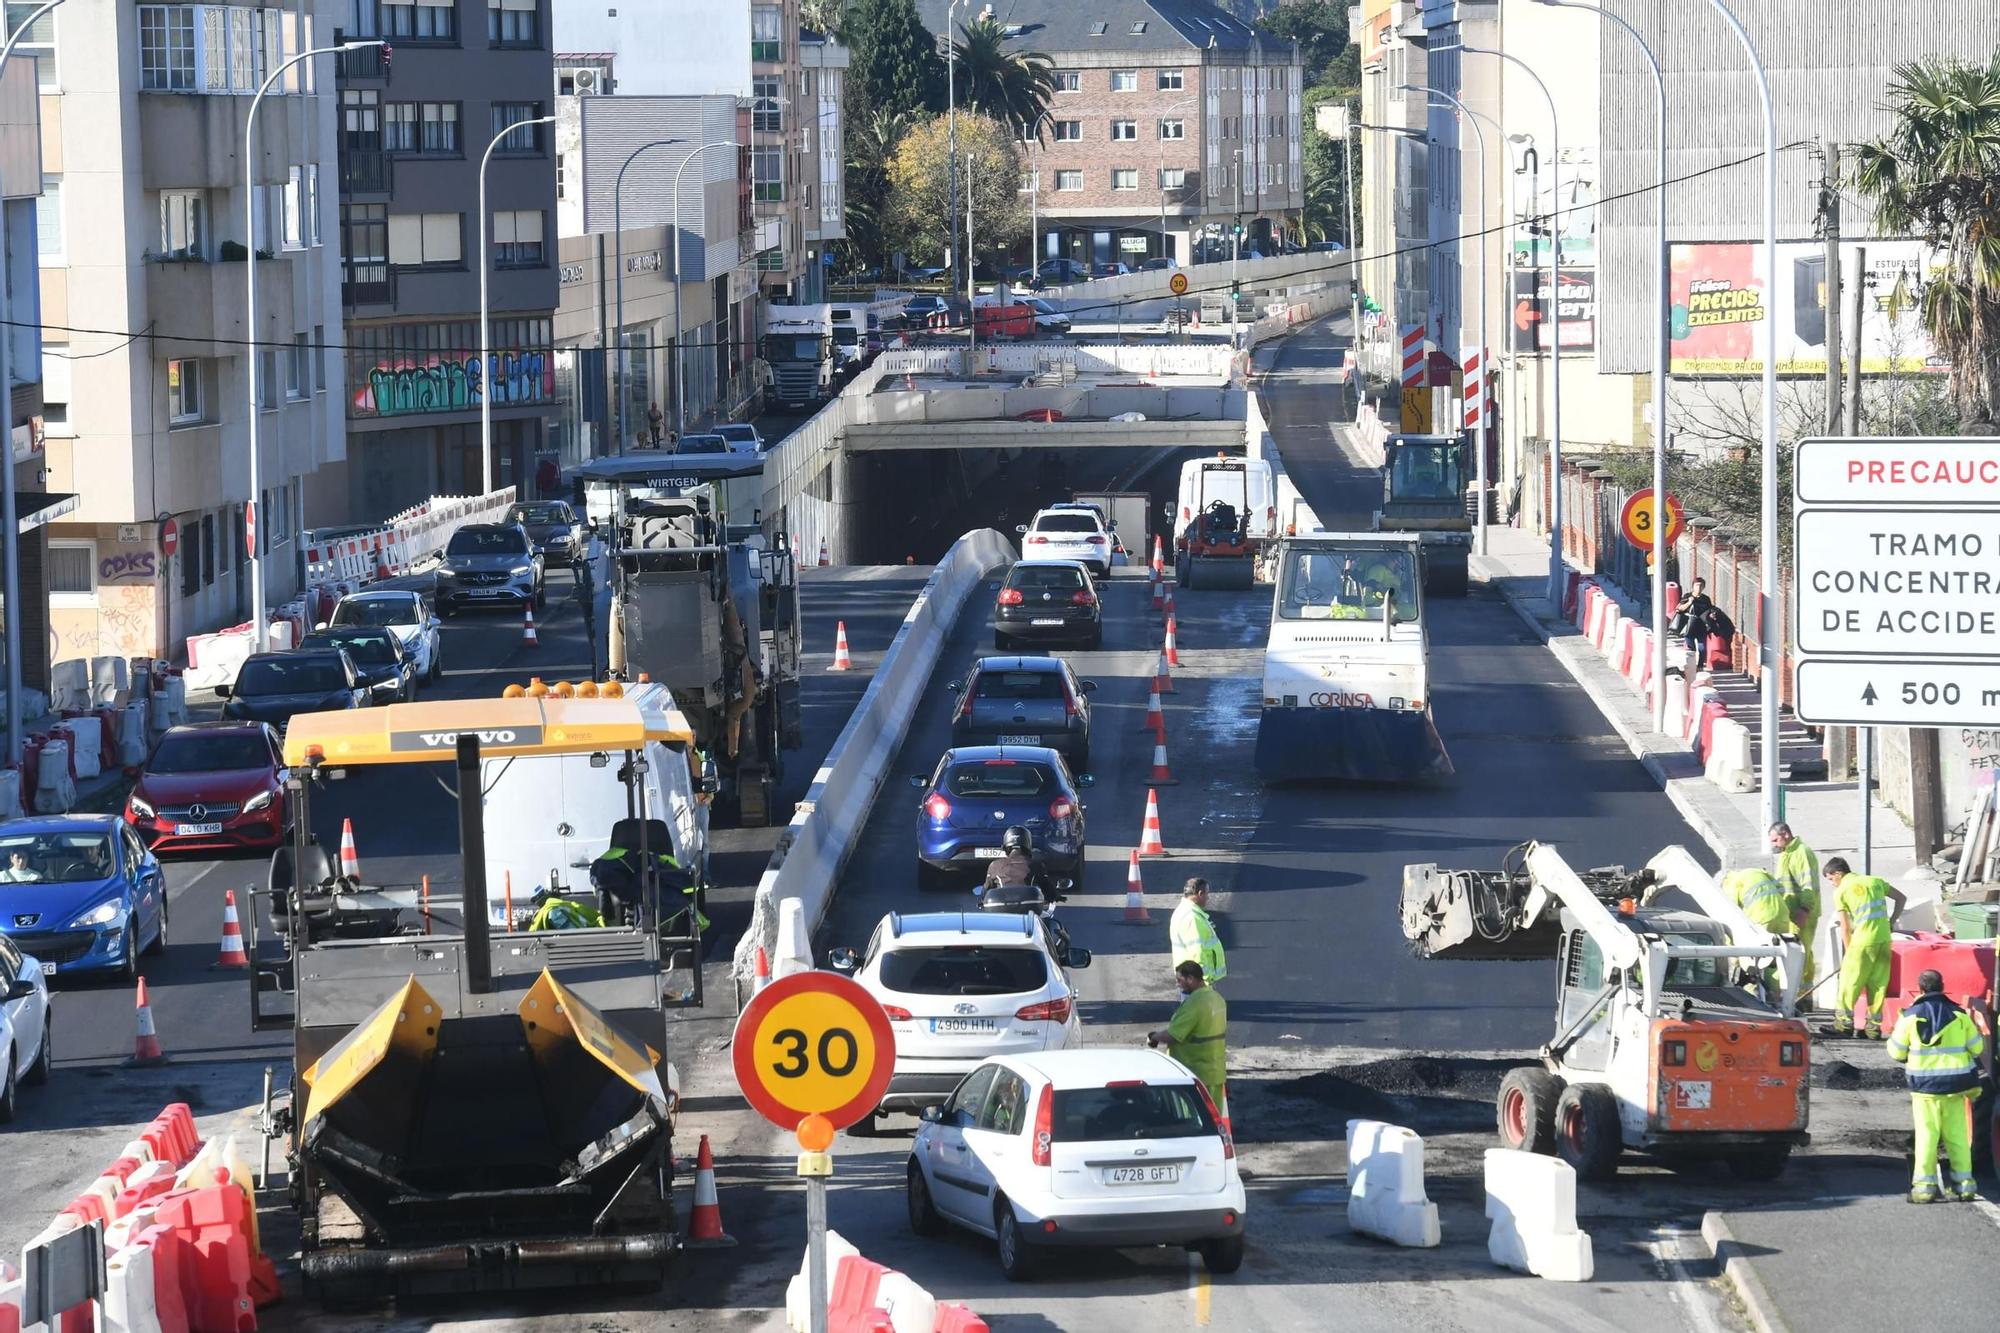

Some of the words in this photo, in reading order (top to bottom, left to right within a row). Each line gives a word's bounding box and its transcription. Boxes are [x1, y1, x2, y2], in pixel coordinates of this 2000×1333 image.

[1173, 280, 1185, 288] 30
[1687, 307, 1763, 327] EXCELENTES
[647, 477, 699, 488] WIRTGEN
[1870, 533, 1983, 557] TRAMO
[1812, 570, 2000, 594] CONCENTR
[1823, 609, 1861, 632] DE
[1309, 690, 1377, 709] CORINSA
[1902, 682, 1961, 705] 500
[420, 730, 516, 747] VOVO
[937, 1018, 968, 1031] 4900
[971, 1018, 995, 1031] HTH
[772, 1026, 859, 1079] 30
[1113, 1168, 1145, 1182] 4728
[1150, 1167, 1174, 1181] GFT
